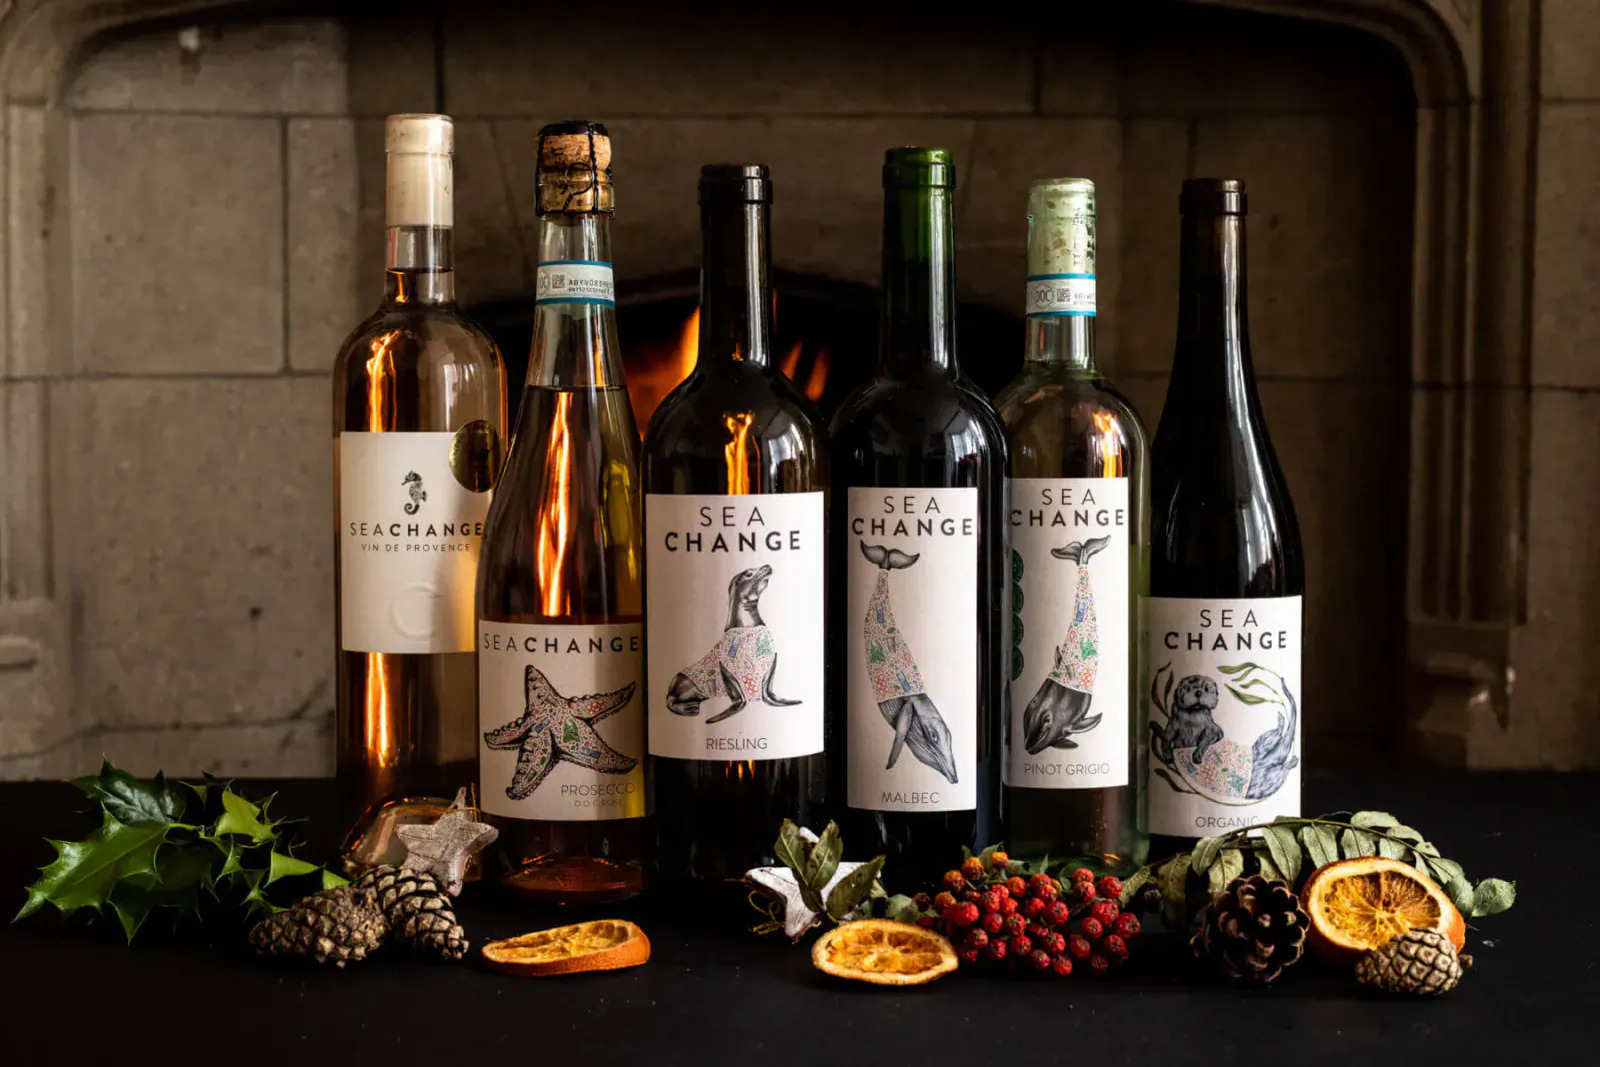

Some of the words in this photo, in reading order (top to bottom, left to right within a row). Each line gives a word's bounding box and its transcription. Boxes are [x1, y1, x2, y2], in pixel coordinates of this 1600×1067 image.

[884, 496, 941, 514] SEA
[1042, 488, 1096, 506] SEA
[700, 506, 765, 527] SEA
[1009, 509, 1124, 527] CHANGE
[851, 518, 973, 536] CHANGE
[361, 543, 379, 551] VIN
[385, 543, 399, 552] DE
[406, 543, 470, 552] PROVENCE
[664, 530, 801, 553] CHANGE
[1200, 609, 1258, 628] SEA
[1164, 630, 1287, 651] CHANGE
[706, 737, 768, 751] RIESLING
[1024, 763, 1062, 775] PINOT
[1065, 762, 1110, 776] GRIGIO
[561, 782, 636, 797] PROSECCO
[881, 791, 940, 804] MALBEC
